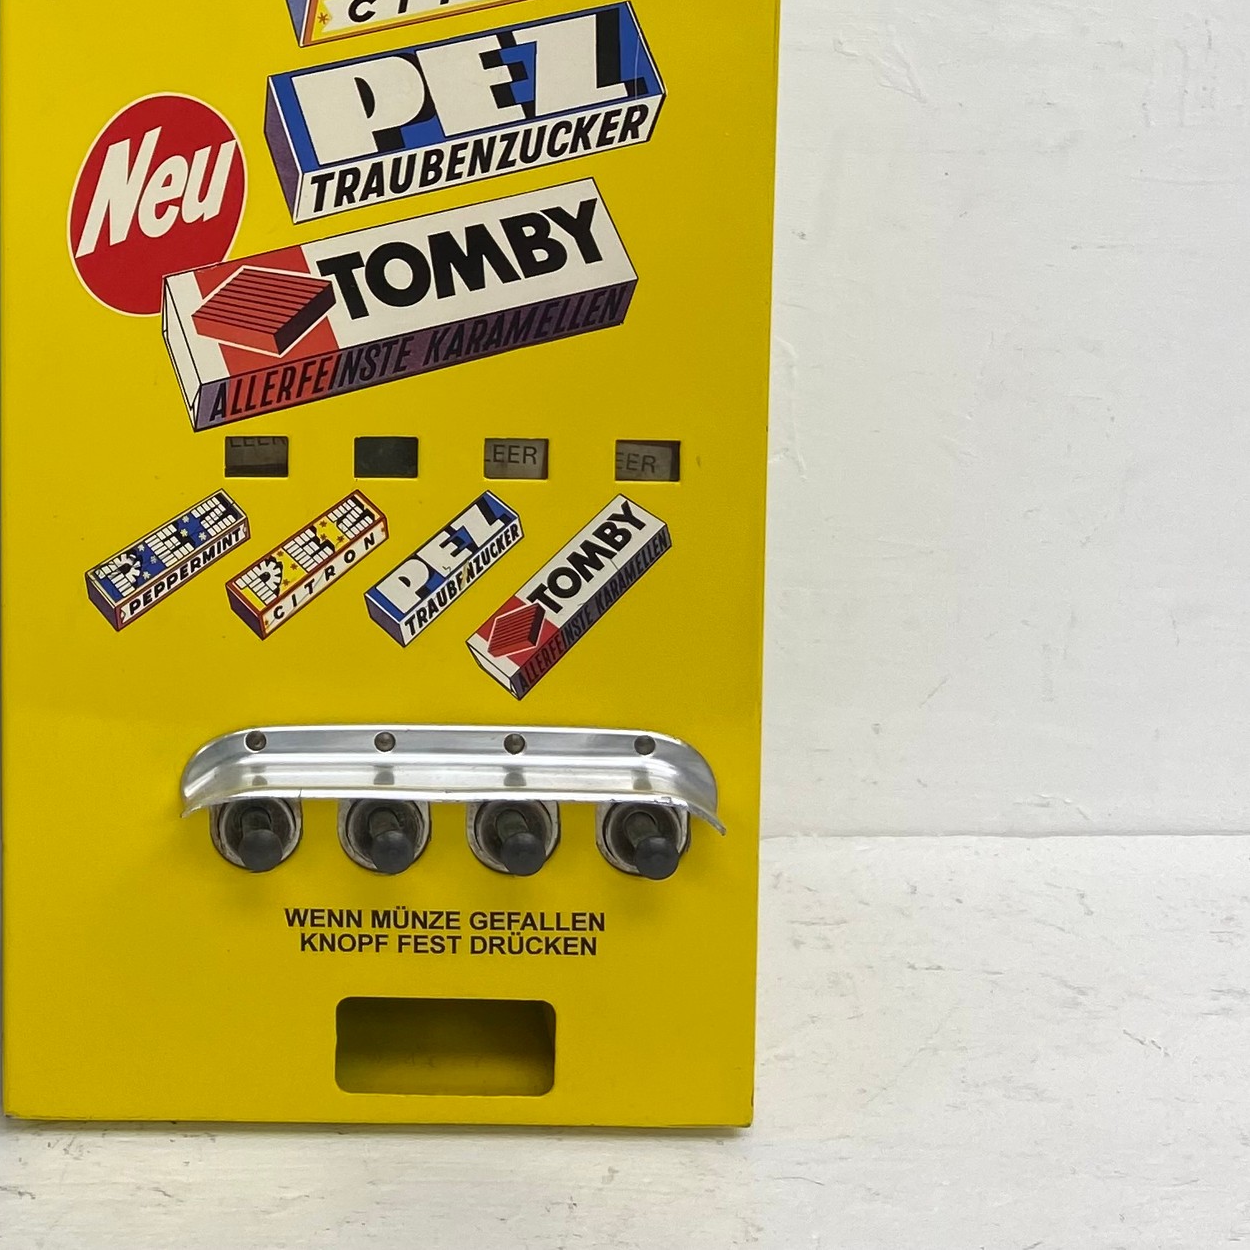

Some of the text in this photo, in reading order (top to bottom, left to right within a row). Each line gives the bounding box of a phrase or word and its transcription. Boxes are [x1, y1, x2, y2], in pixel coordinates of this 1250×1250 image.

[291, 12, 632, 166] PEZ
[74, 126, 237, 258] Neu
[310, 103, 649, 213] TRAUBENZUCKER
[316, 197, 598, 320] TOMBY
[209, 283, 629, 422] ALLERFEINSTE KARAMELLEN
[484, 444, 538, 465] EER
[96, 496, 237, 597] PEZ
[129, 526, 242, 616] PEPPERMINT
[235, 498, 374, 606] PEZ
[273, 534, 376, 620] CITRON
[375, 504, 506, 614] PEZ
[526, 500, 647, 614] TOMBY
[284, 906, 605, 932] WENN MÜNZE GEFALLEN
[300, 932, 597, 956] KNOPF FEST DRÜCKEN
